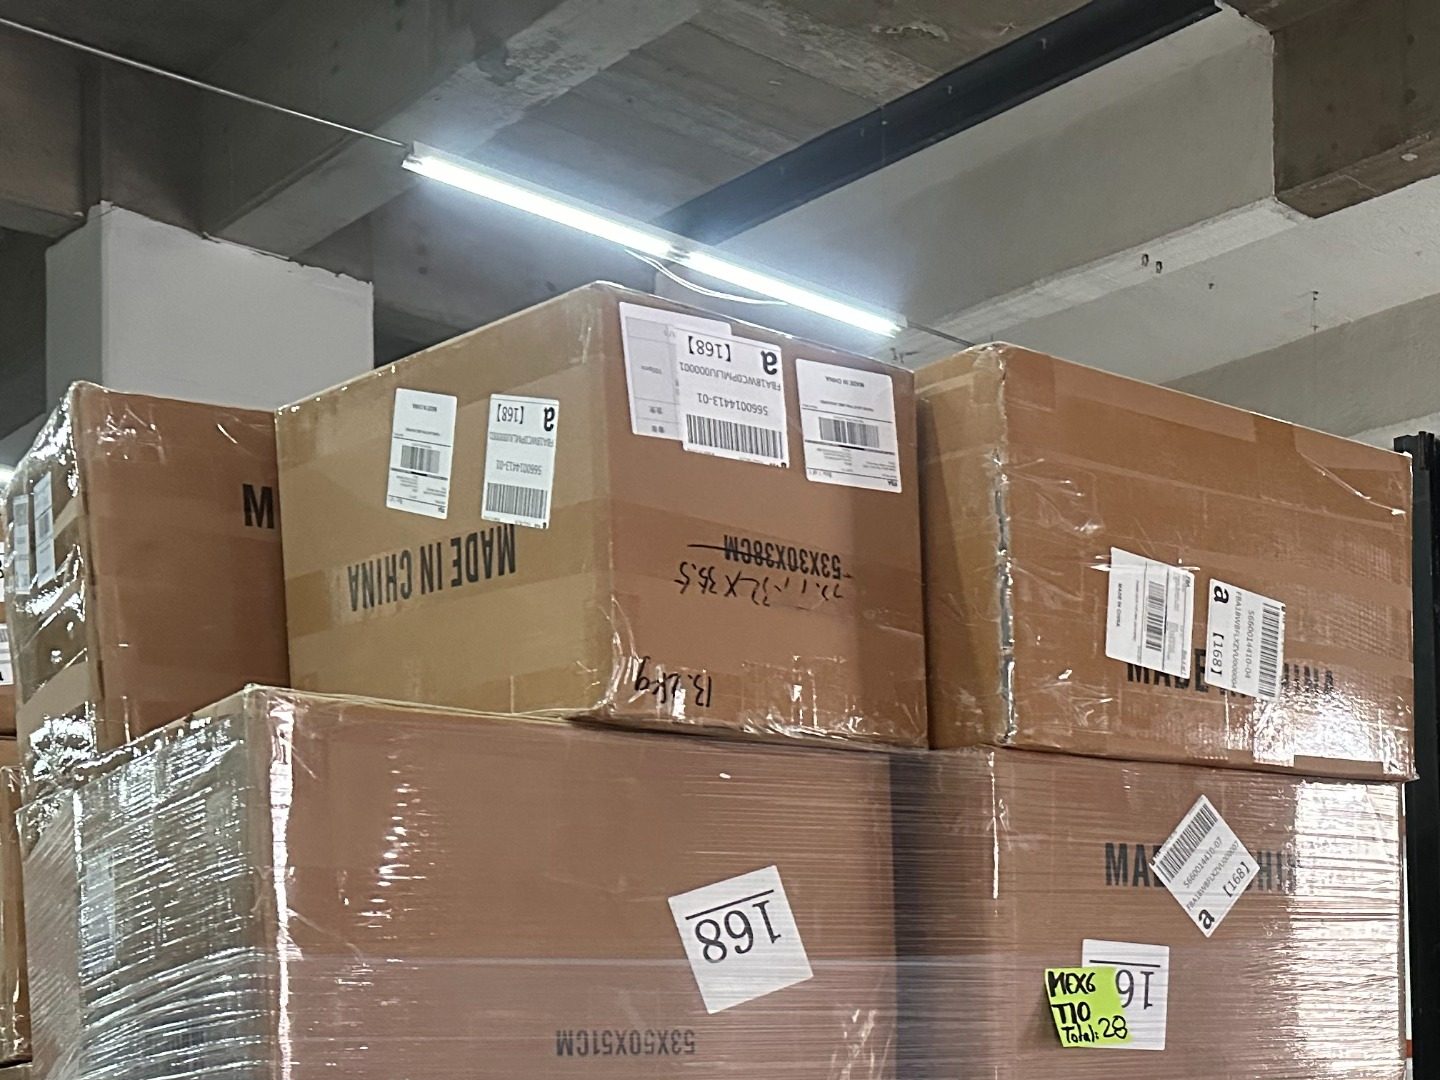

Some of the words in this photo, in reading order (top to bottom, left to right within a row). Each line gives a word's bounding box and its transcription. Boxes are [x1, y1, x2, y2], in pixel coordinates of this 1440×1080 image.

[688, 335, 731, 362] 【168】
[761, 350, 778, 375] a
[541, 406, 555, 431] a
[697, 392, 769, 416] 5660014413-01
[420, 545, 443, 595] IN
[451, 524, 517, 587] MADE
[348, 552, 412, 611] CHINA
[1213, 585, 1230, 605] a
[1211, 632, 1225, 676] 【168】
[1199, 908, 1216, 930] a
[1223, 861, 1251, 898] 【168】
[694, 899, 782, 964] 168
[1047, 970, 1096, 998] MEX6
[556, 1029, 696, 1057] 53X50X51CM
